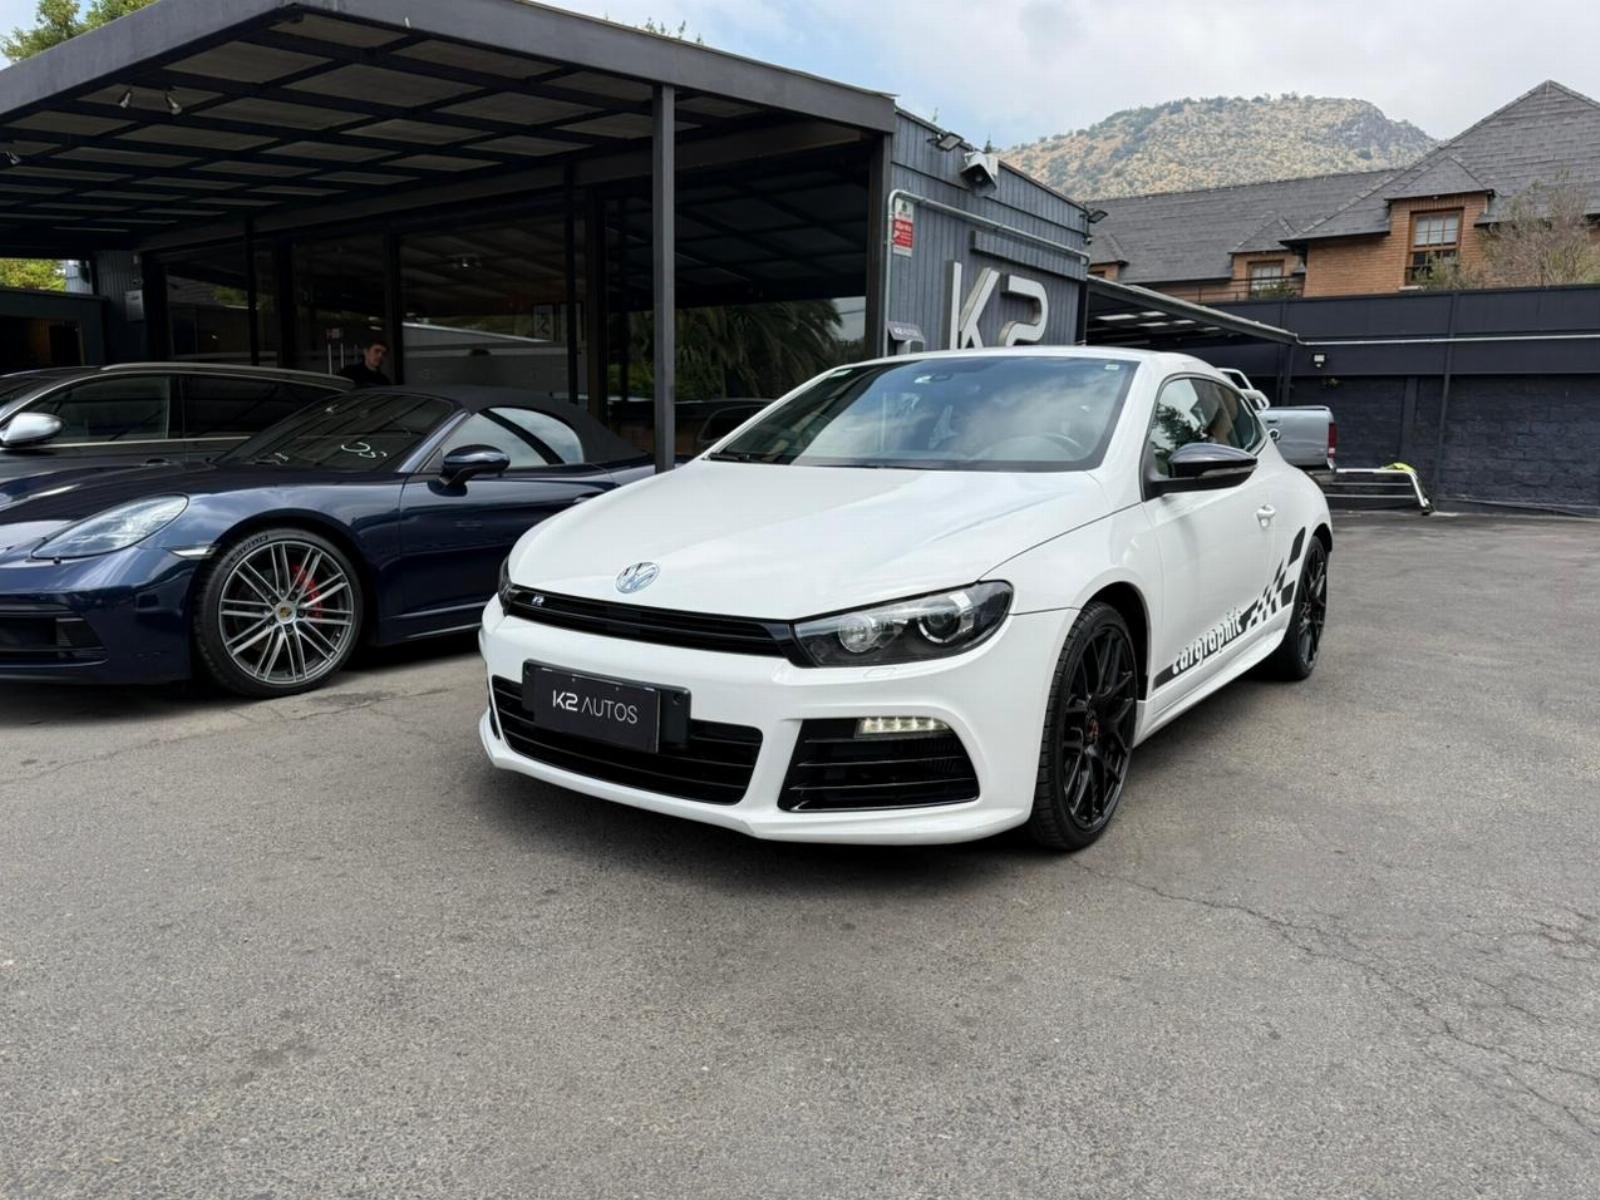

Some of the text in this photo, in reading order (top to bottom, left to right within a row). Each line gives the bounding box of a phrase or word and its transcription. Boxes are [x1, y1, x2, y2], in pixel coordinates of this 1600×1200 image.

[950, 262, 1049, 349] K2
[552, 689, 638, 724] K2 AUTOS
